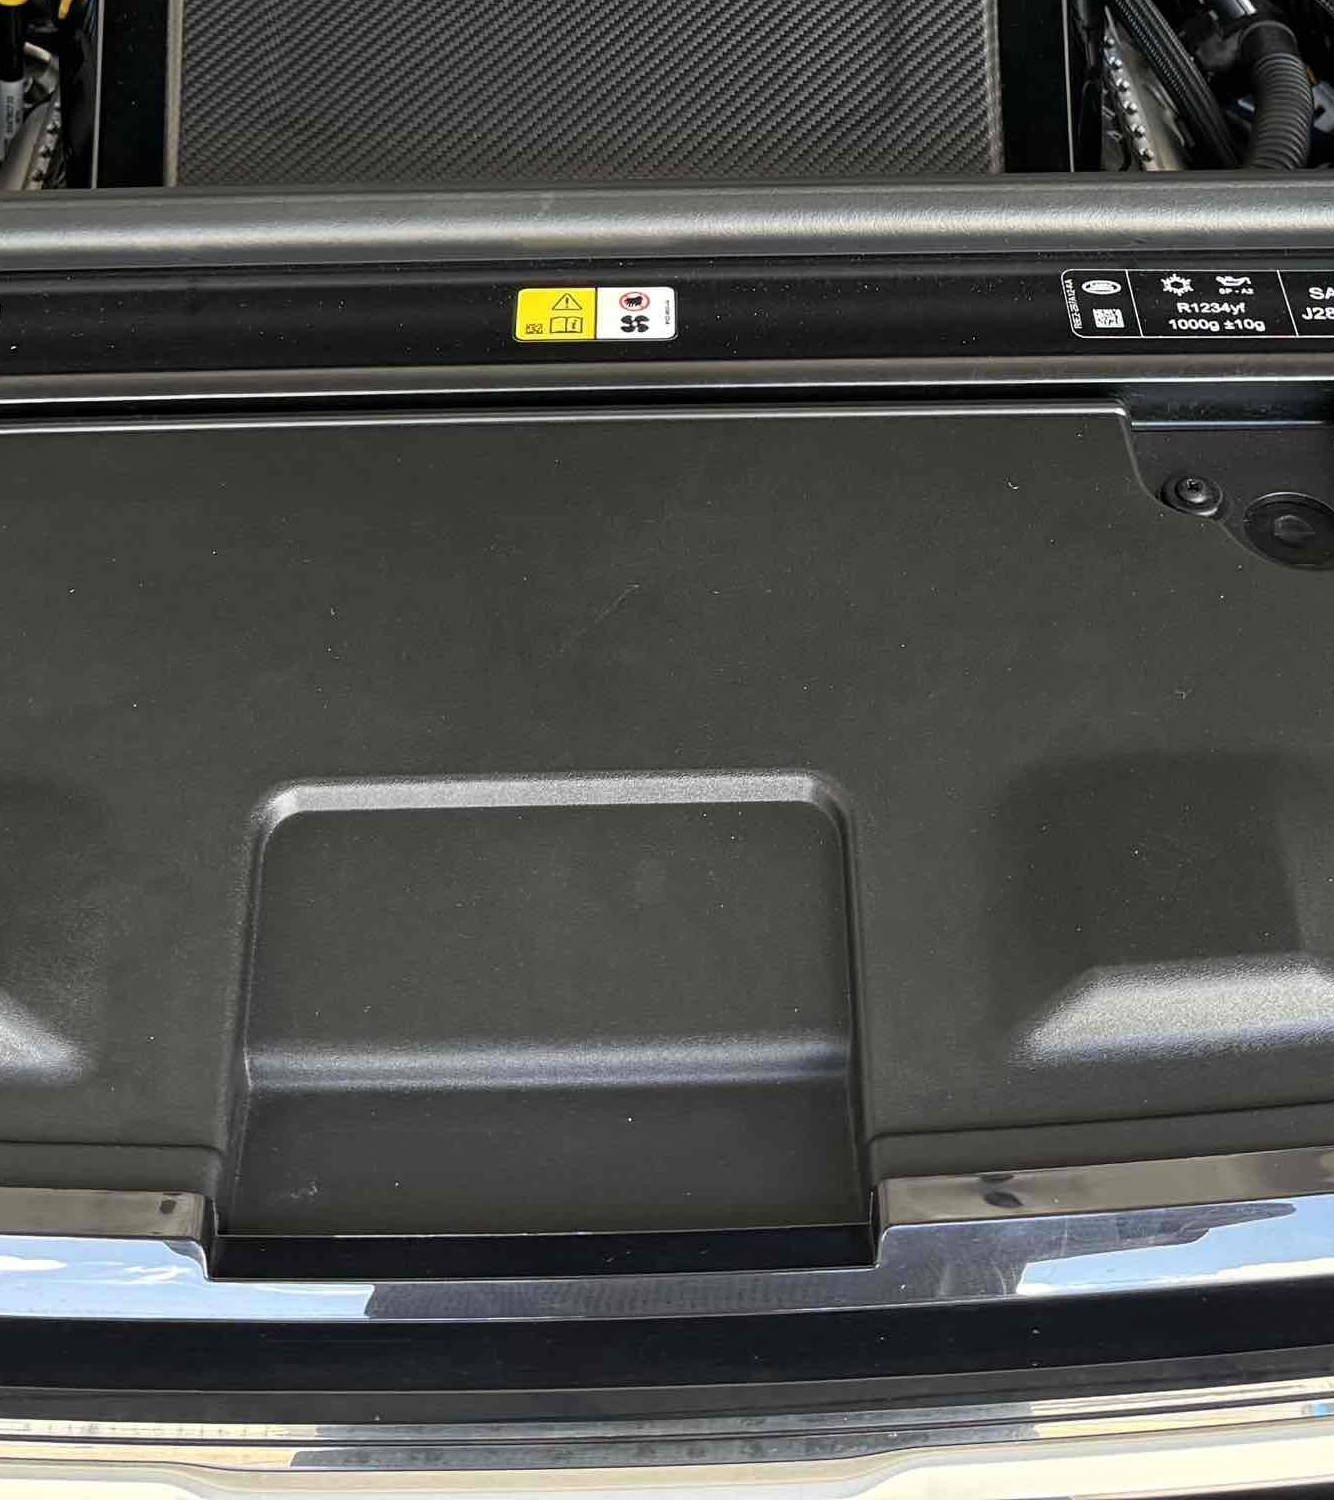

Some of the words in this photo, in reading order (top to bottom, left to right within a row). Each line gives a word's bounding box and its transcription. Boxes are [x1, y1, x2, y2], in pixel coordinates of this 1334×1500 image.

[1176, 301, 1246, 316] R1234yf
[1168, 318, 1220, 332] 1000g
[1223, 318, 1266, 332] ±10g
